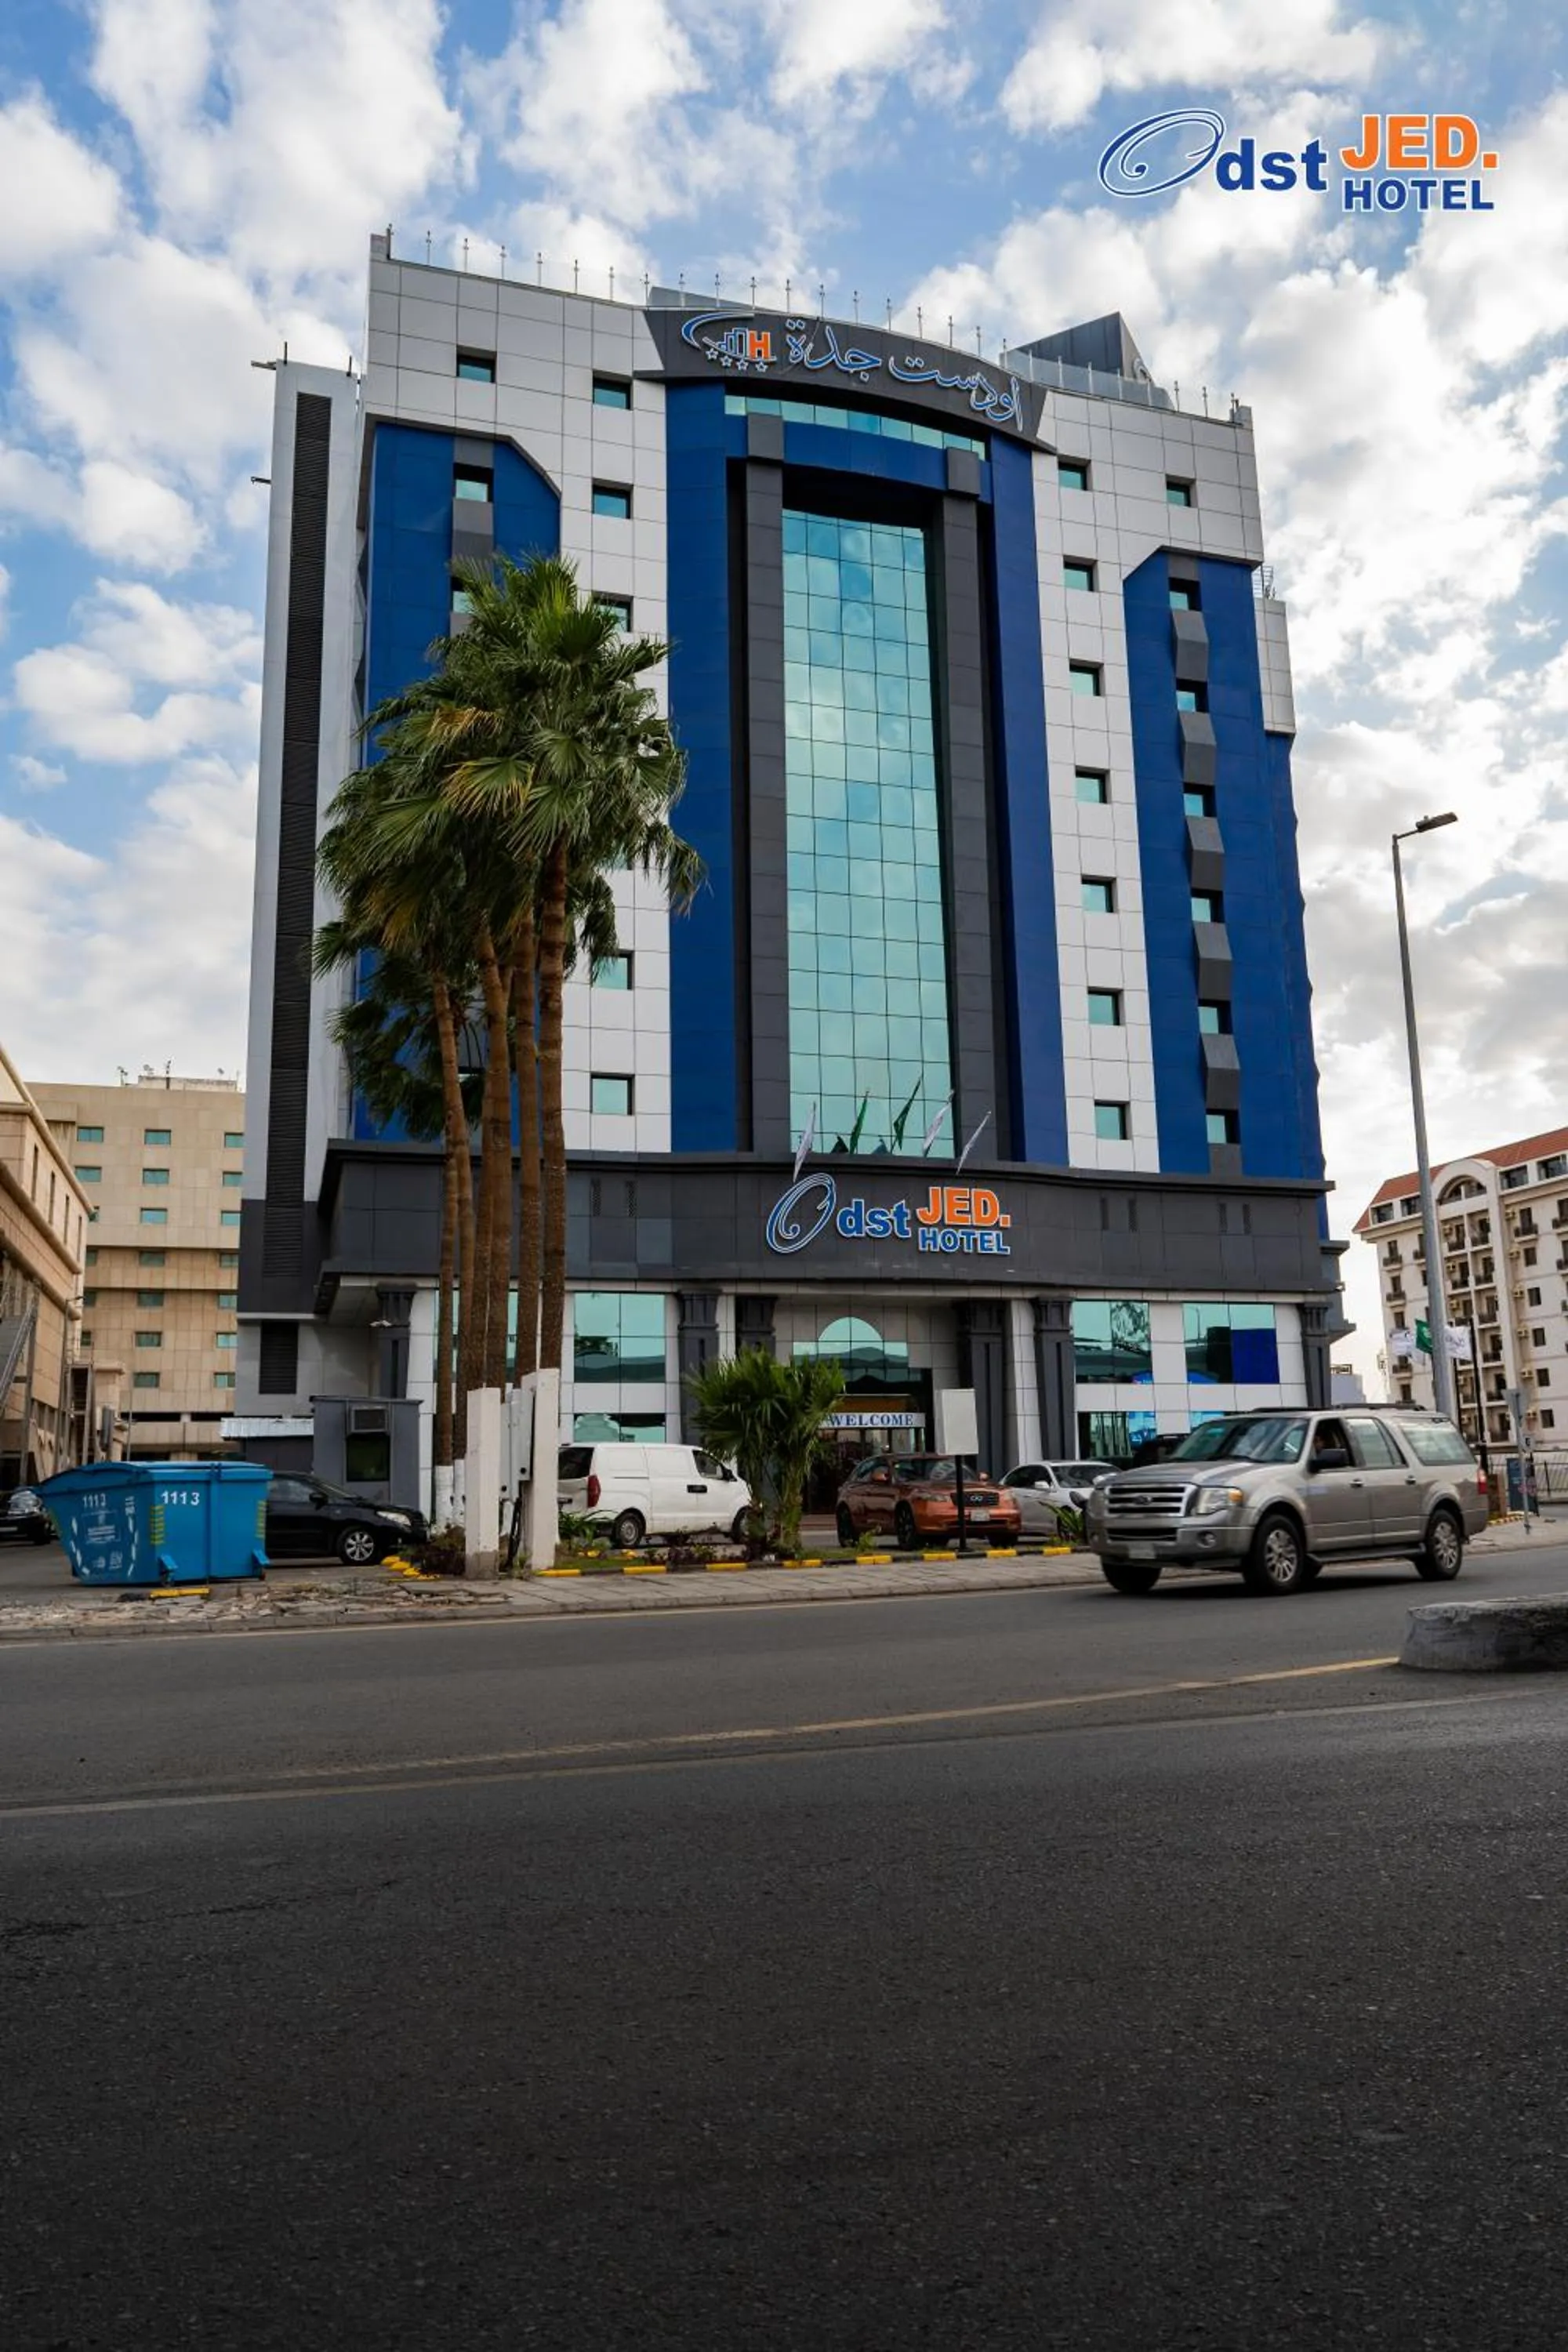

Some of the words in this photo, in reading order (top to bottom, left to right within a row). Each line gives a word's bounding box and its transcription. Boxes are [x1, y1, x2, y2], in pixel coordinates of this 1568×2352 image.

[785, 318, 882, 380] جدة
[918, 1228, 1011, 1254] HOTEL
[827, 1414, 914, 1426] WELCOME
[162, 1491, 200, 1506] 1113
